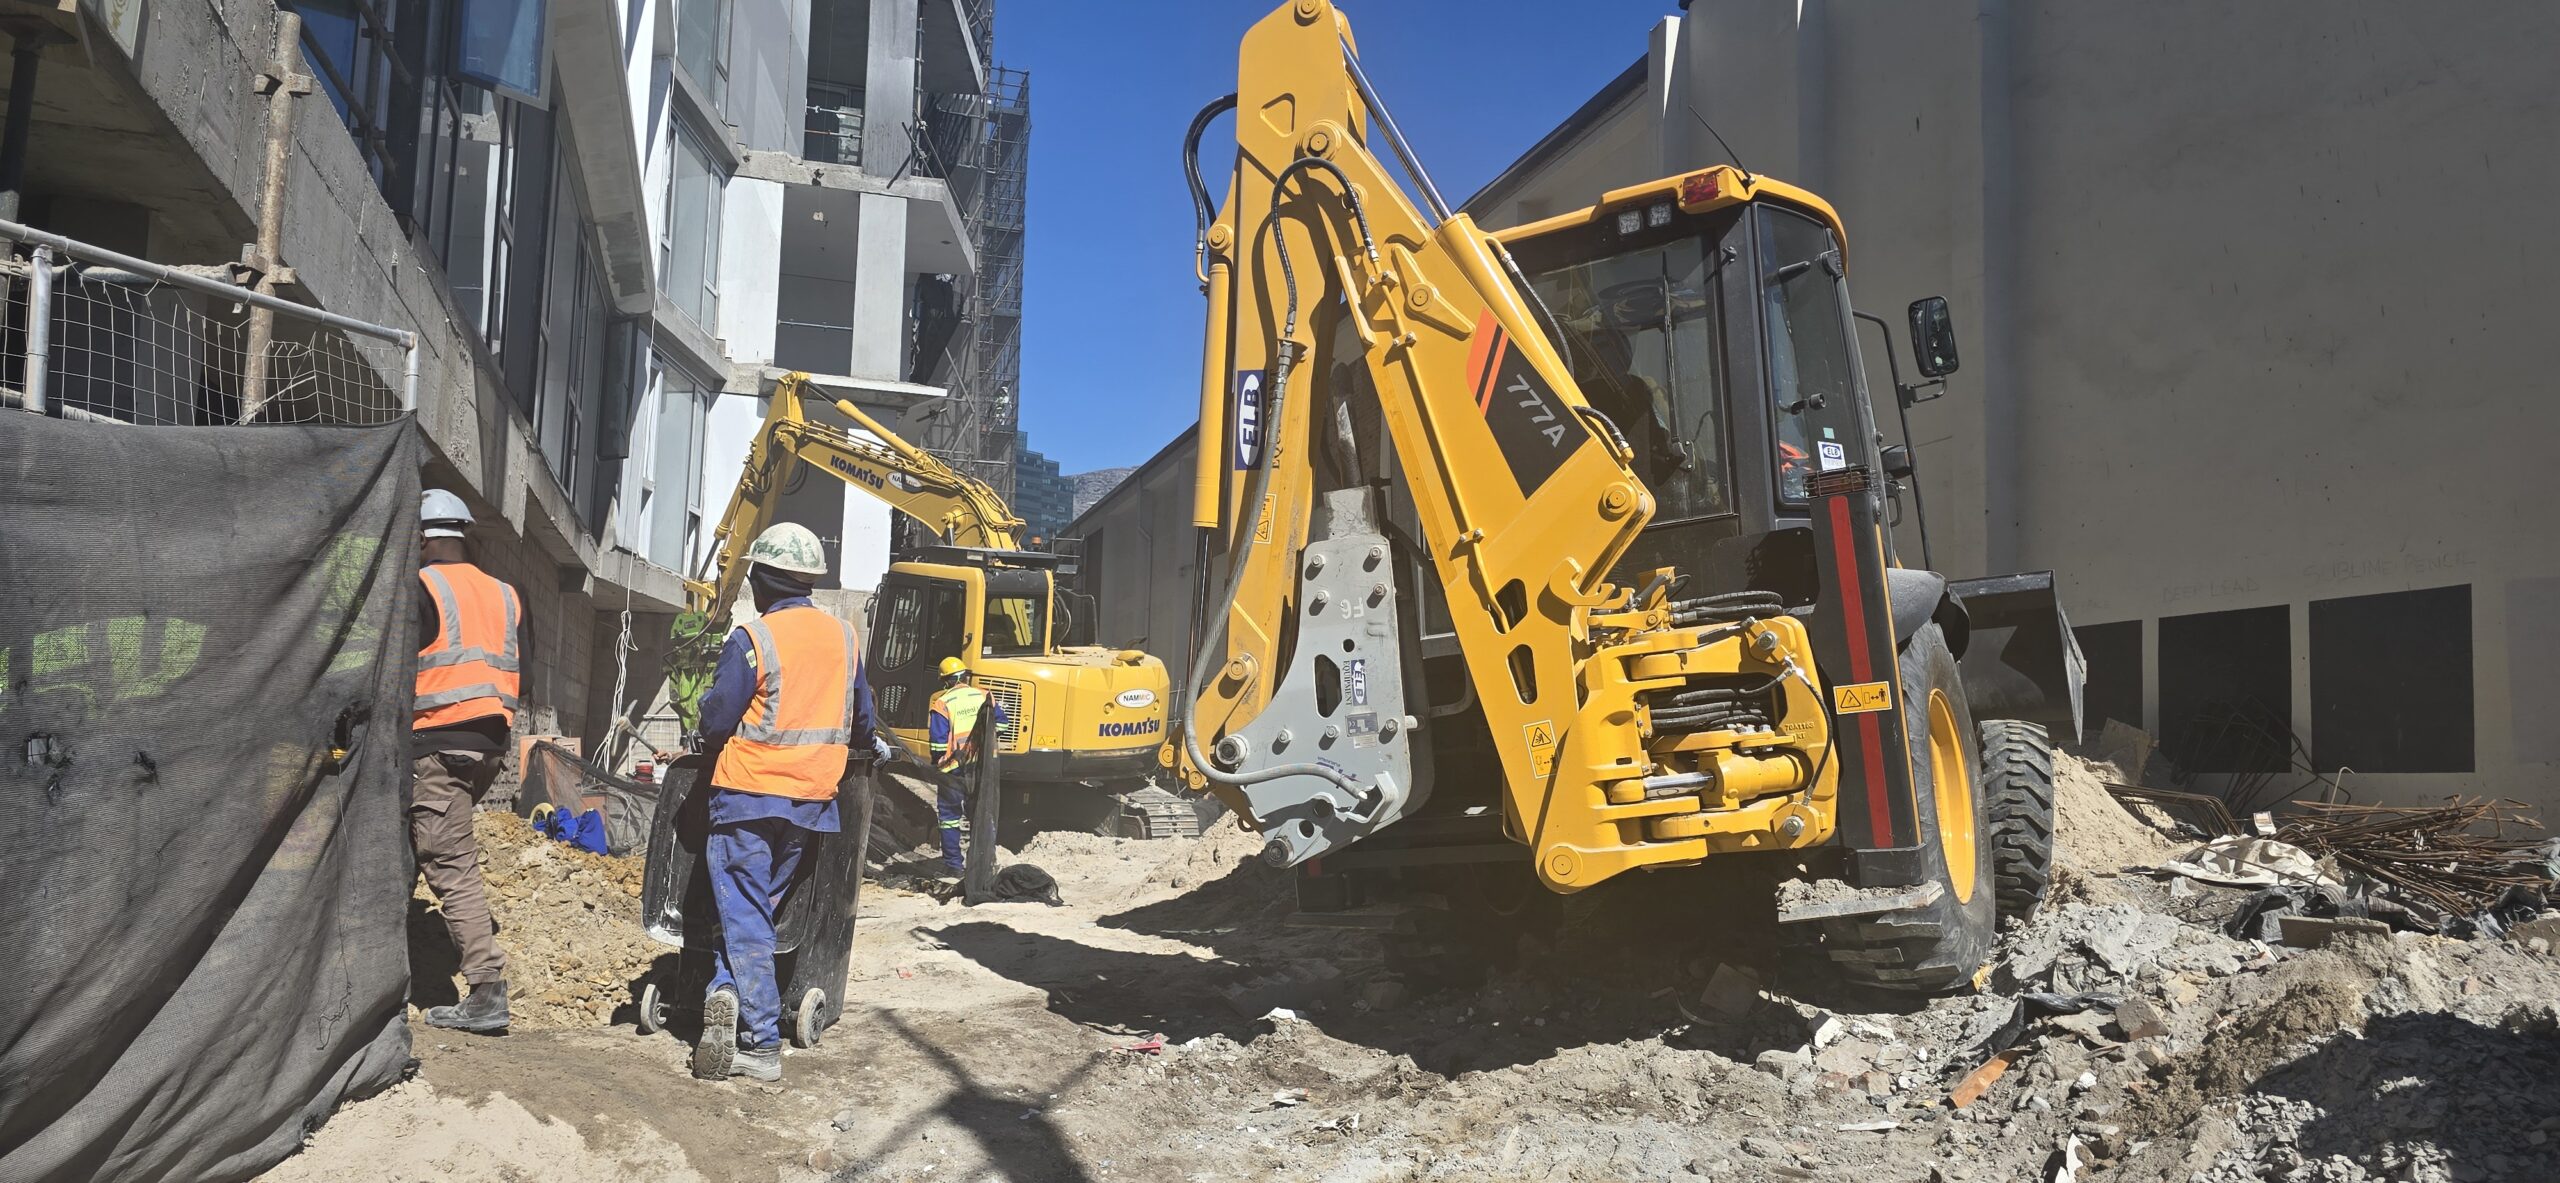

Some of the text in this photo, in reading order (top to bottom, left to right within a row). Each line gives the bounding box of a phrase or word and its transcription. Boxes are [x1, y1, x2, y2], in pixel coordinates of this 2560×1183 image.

[1243, 388, 1259, 446] ELB
[1506, 373, 1566, 448] 777A
[1827, 447, 1839, 456] ELB
[830, 454, 884, 490] KOMATSU
[1343, 660, 1352, 705] EQUIPMENT
[1355, 671, 1364, 697] ELB
[1099, 717, 1160, 737] KOMATSU
